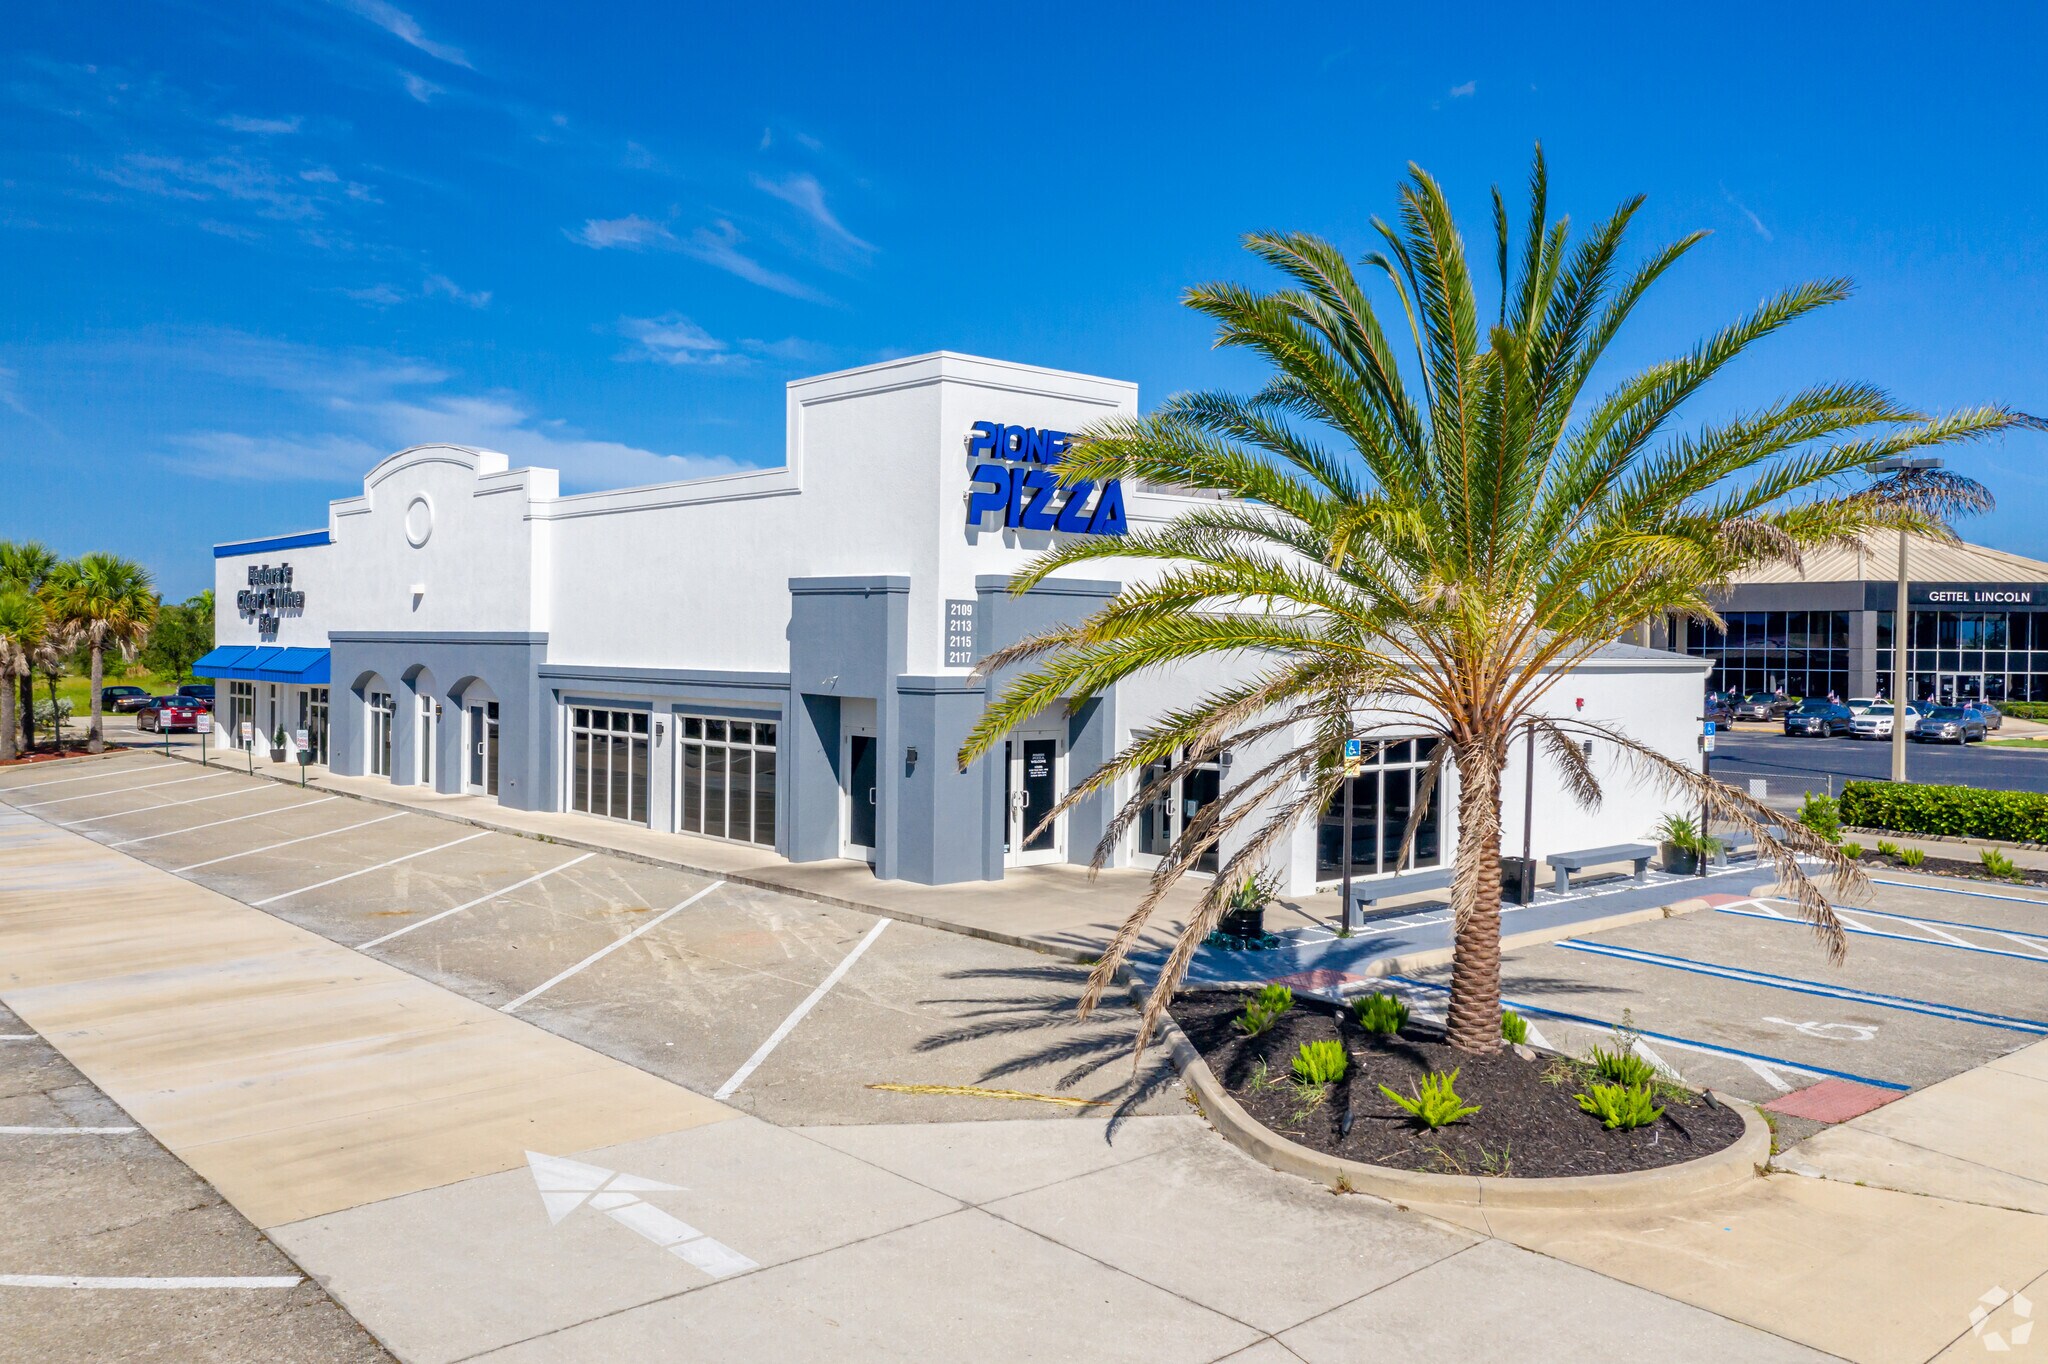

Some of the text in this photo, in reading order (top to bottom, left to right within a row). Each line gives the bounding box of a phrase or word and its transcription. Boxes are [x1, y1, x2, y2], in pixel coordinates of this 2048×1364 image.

[969, 421, 1108, 468] PIONE
[966, 464, 1128, 536] PIZZA
[275, 588, 305, 608] Wine
[1929, 591, 2030, 602] GETTEL LINCOLN
[950, 603, 972, 616] 2109
[259, 614, 279, 633] Bar
[950, 619, 972, 632] 2113
[949, 635, 971, 648] 2115
[949, 651, 971, 663] 2117
